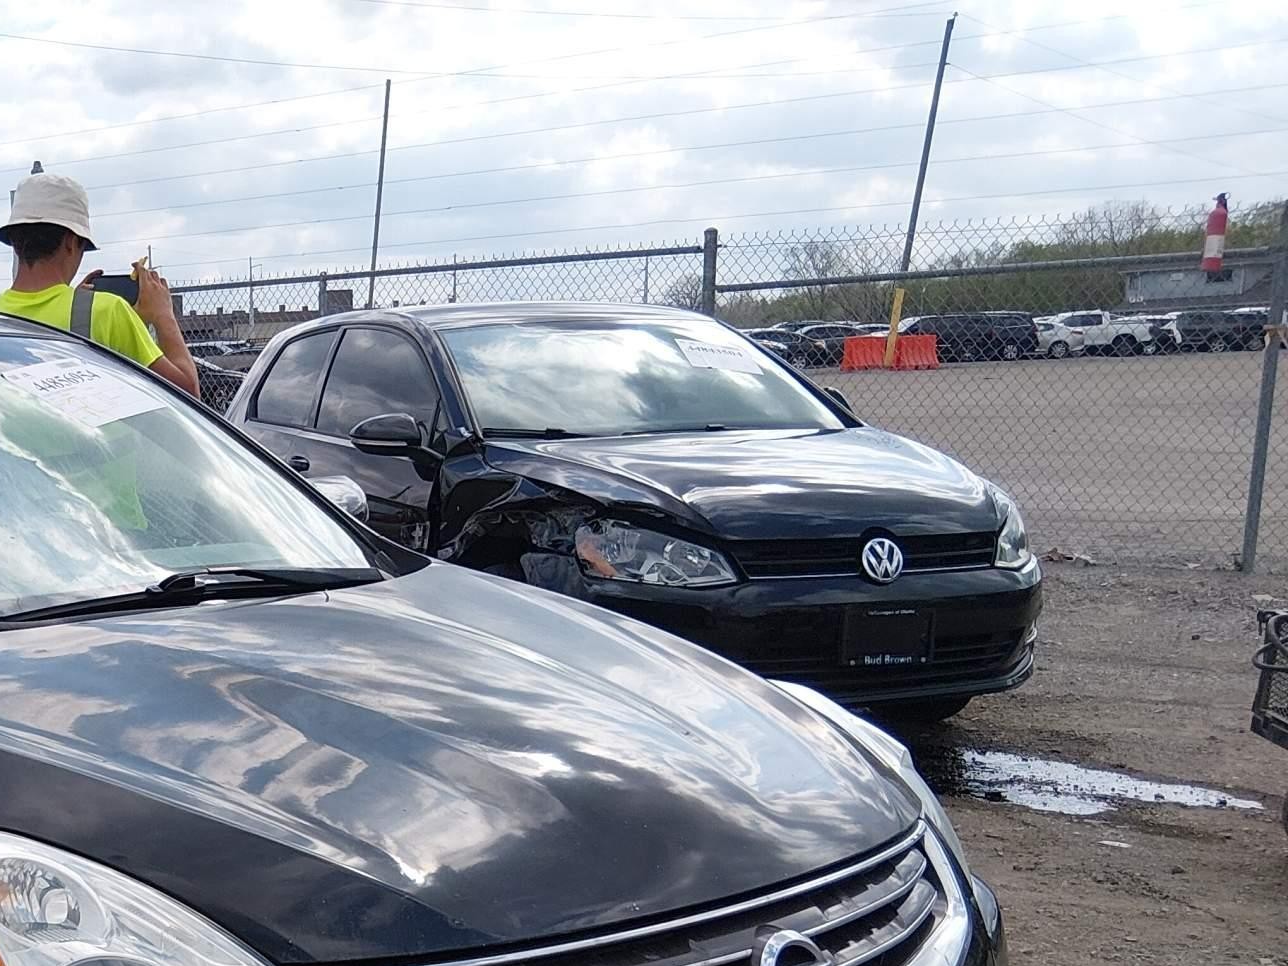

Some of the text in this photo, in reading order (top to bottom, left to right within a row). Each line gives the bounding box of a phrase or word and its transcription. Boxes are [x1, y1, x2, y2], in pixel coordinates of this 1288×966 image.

[33, 370, 101, 392] 44856954
[864, 655, 912, 665] Bud Brown
